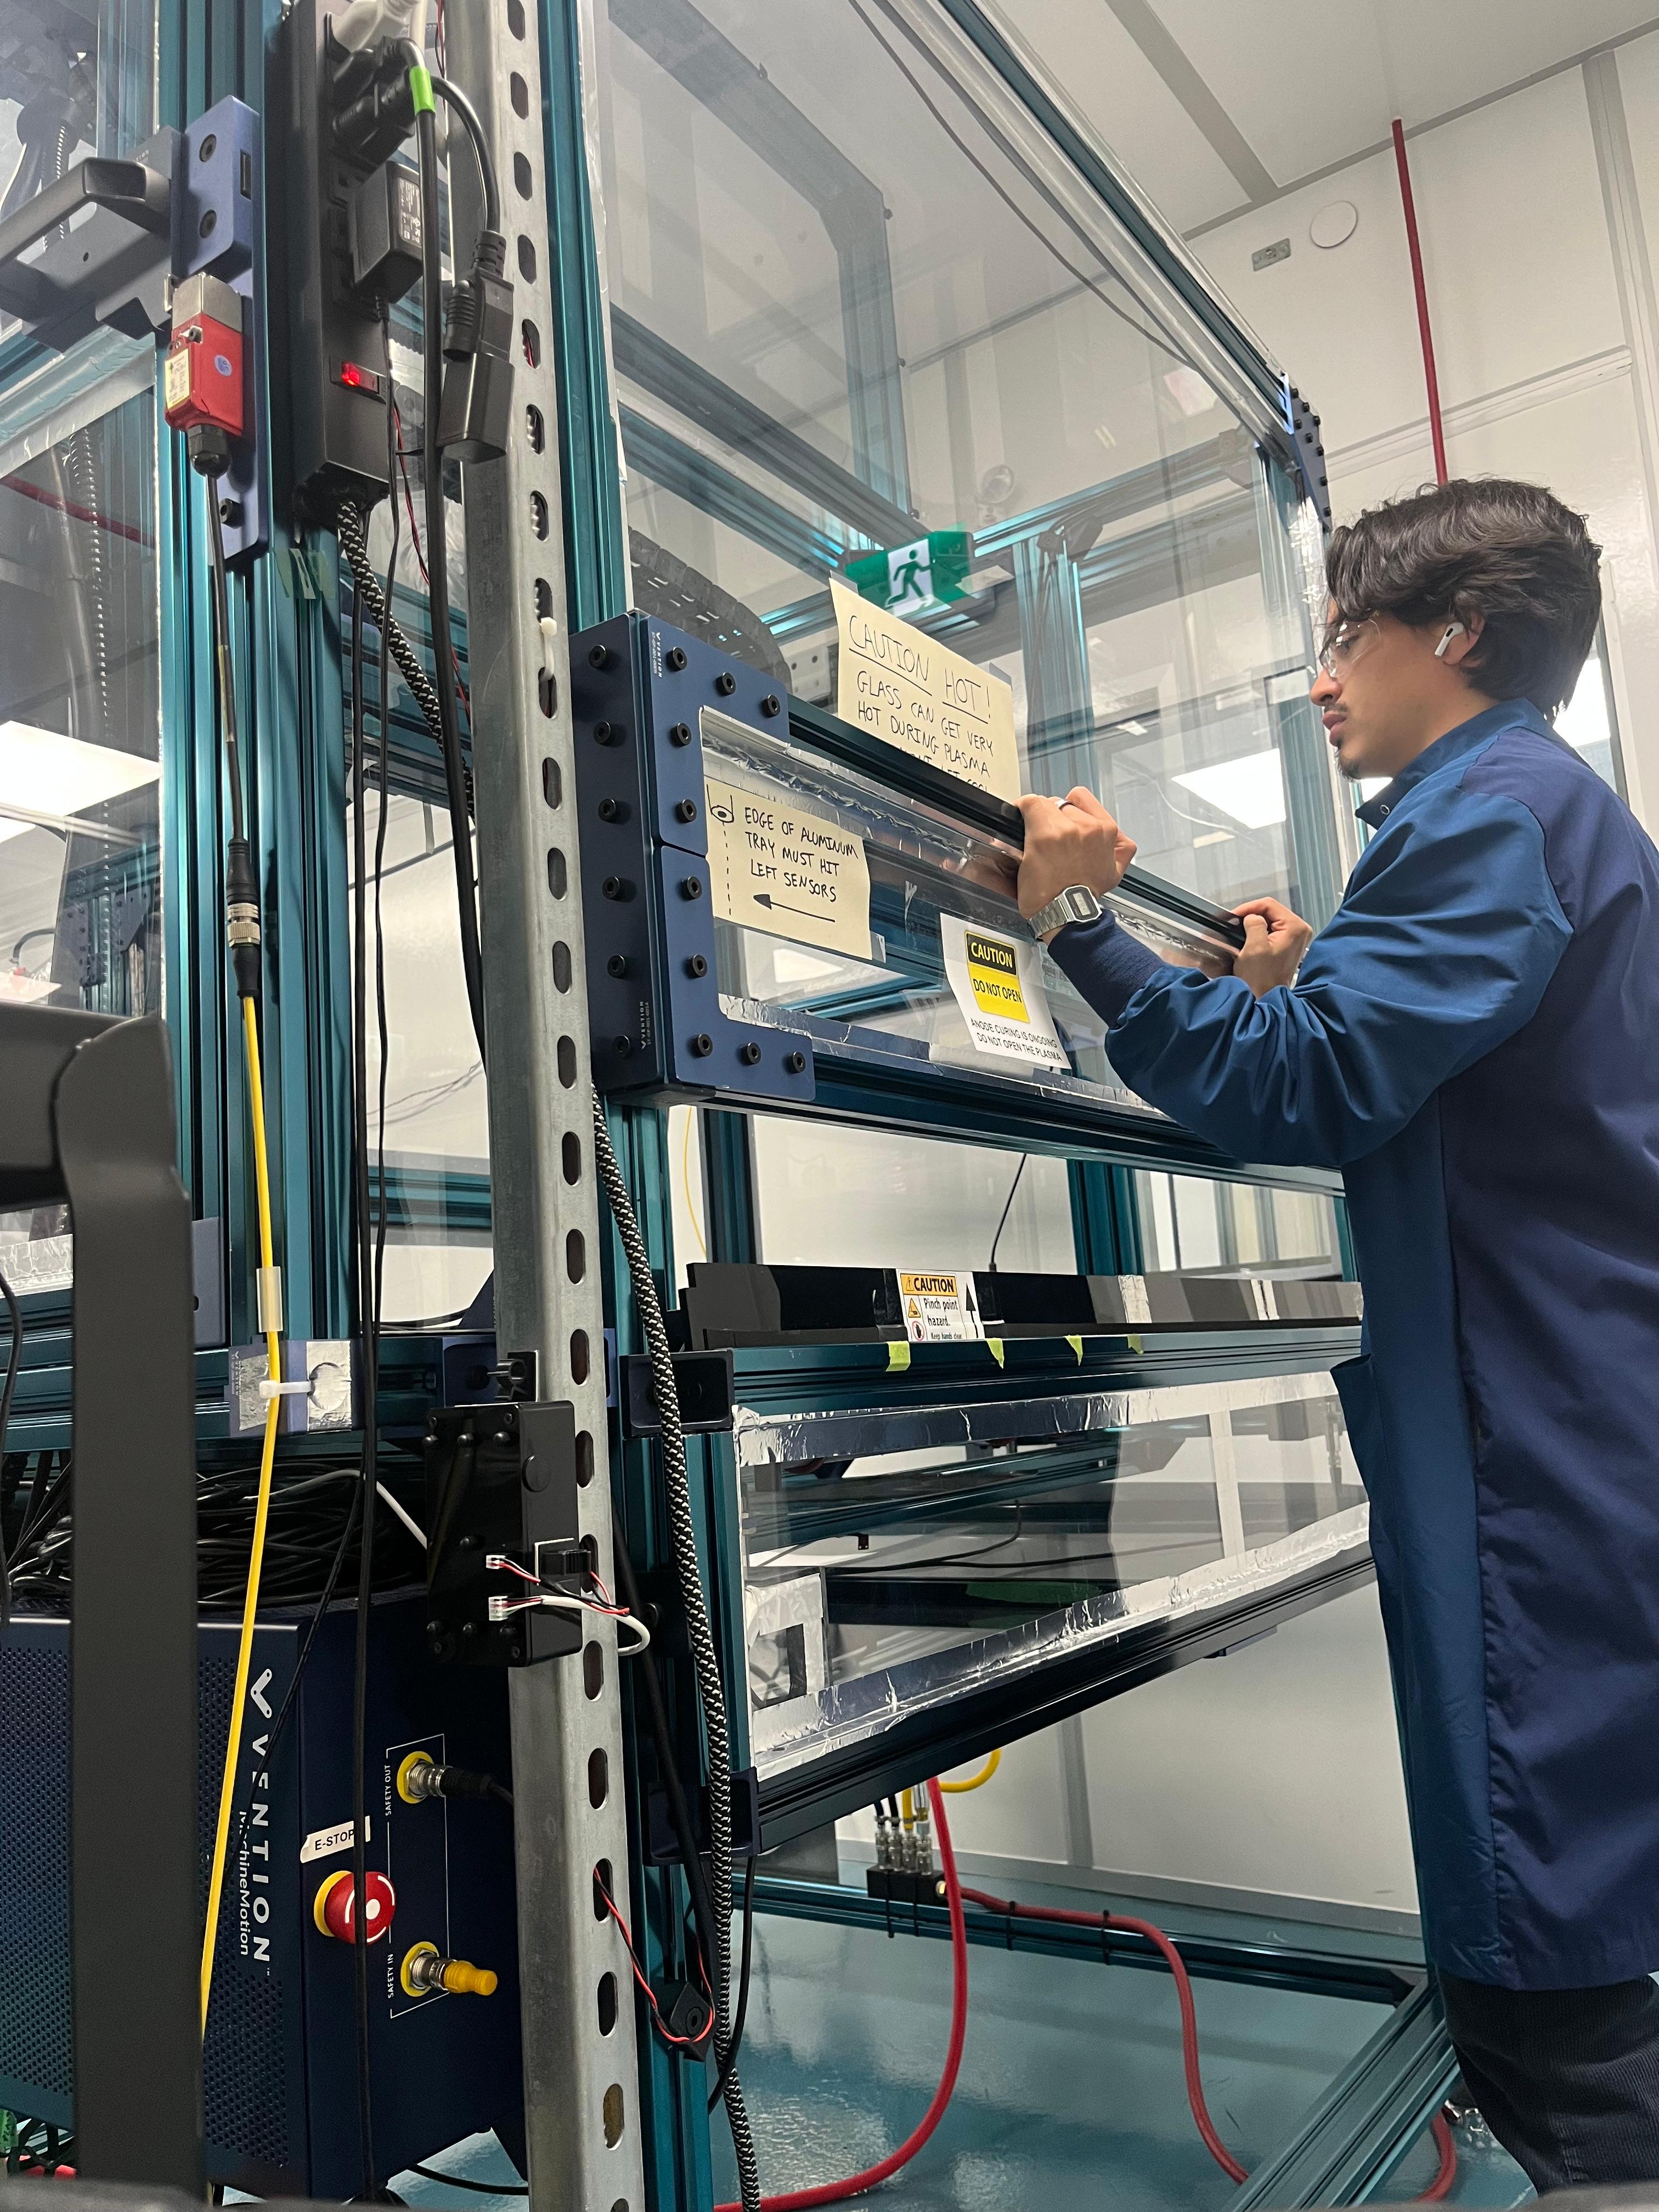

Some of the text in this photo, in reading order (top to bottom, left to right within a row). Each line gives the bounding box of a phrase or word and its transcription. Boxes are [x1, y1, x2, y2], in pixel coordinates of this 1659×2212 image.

[849, 615, 991, 719] CAUTION HOT!
[857, 670, 993, 757] GLASS CAN GET VERY
[858, 701, 881, 726] HOT
[890, 715, 939, 754] DURING
[944, 743, 990, 778] PLASMA
[744, 807, 859, 859] EDGE OF ALUMINUM
[744, 831, 840, 876] TRAY MUST HIT
[751, 859, 837, 902] LEFT SENSORS
[970, 942, 1013, 968] CAUTION
[973, 978, 1022, 1003] DO NOT OPEN
[970, 1018, 1057, 1048] ANODE CURING IS ONGOING
[977, 1032, 1063, 1062] DO NOT OPEN THE PLASMA
[913, 1277, 955, 1293] CAUTION
[923, 1297, 958, 1312] Pinch point
[927, 1314, 951, 1327] hazard.
[252, 1734, 270, 1962] VENTION
[314, 1829, 354, 1851] E-STOP
[387, 1954, 394, 1964] IN
